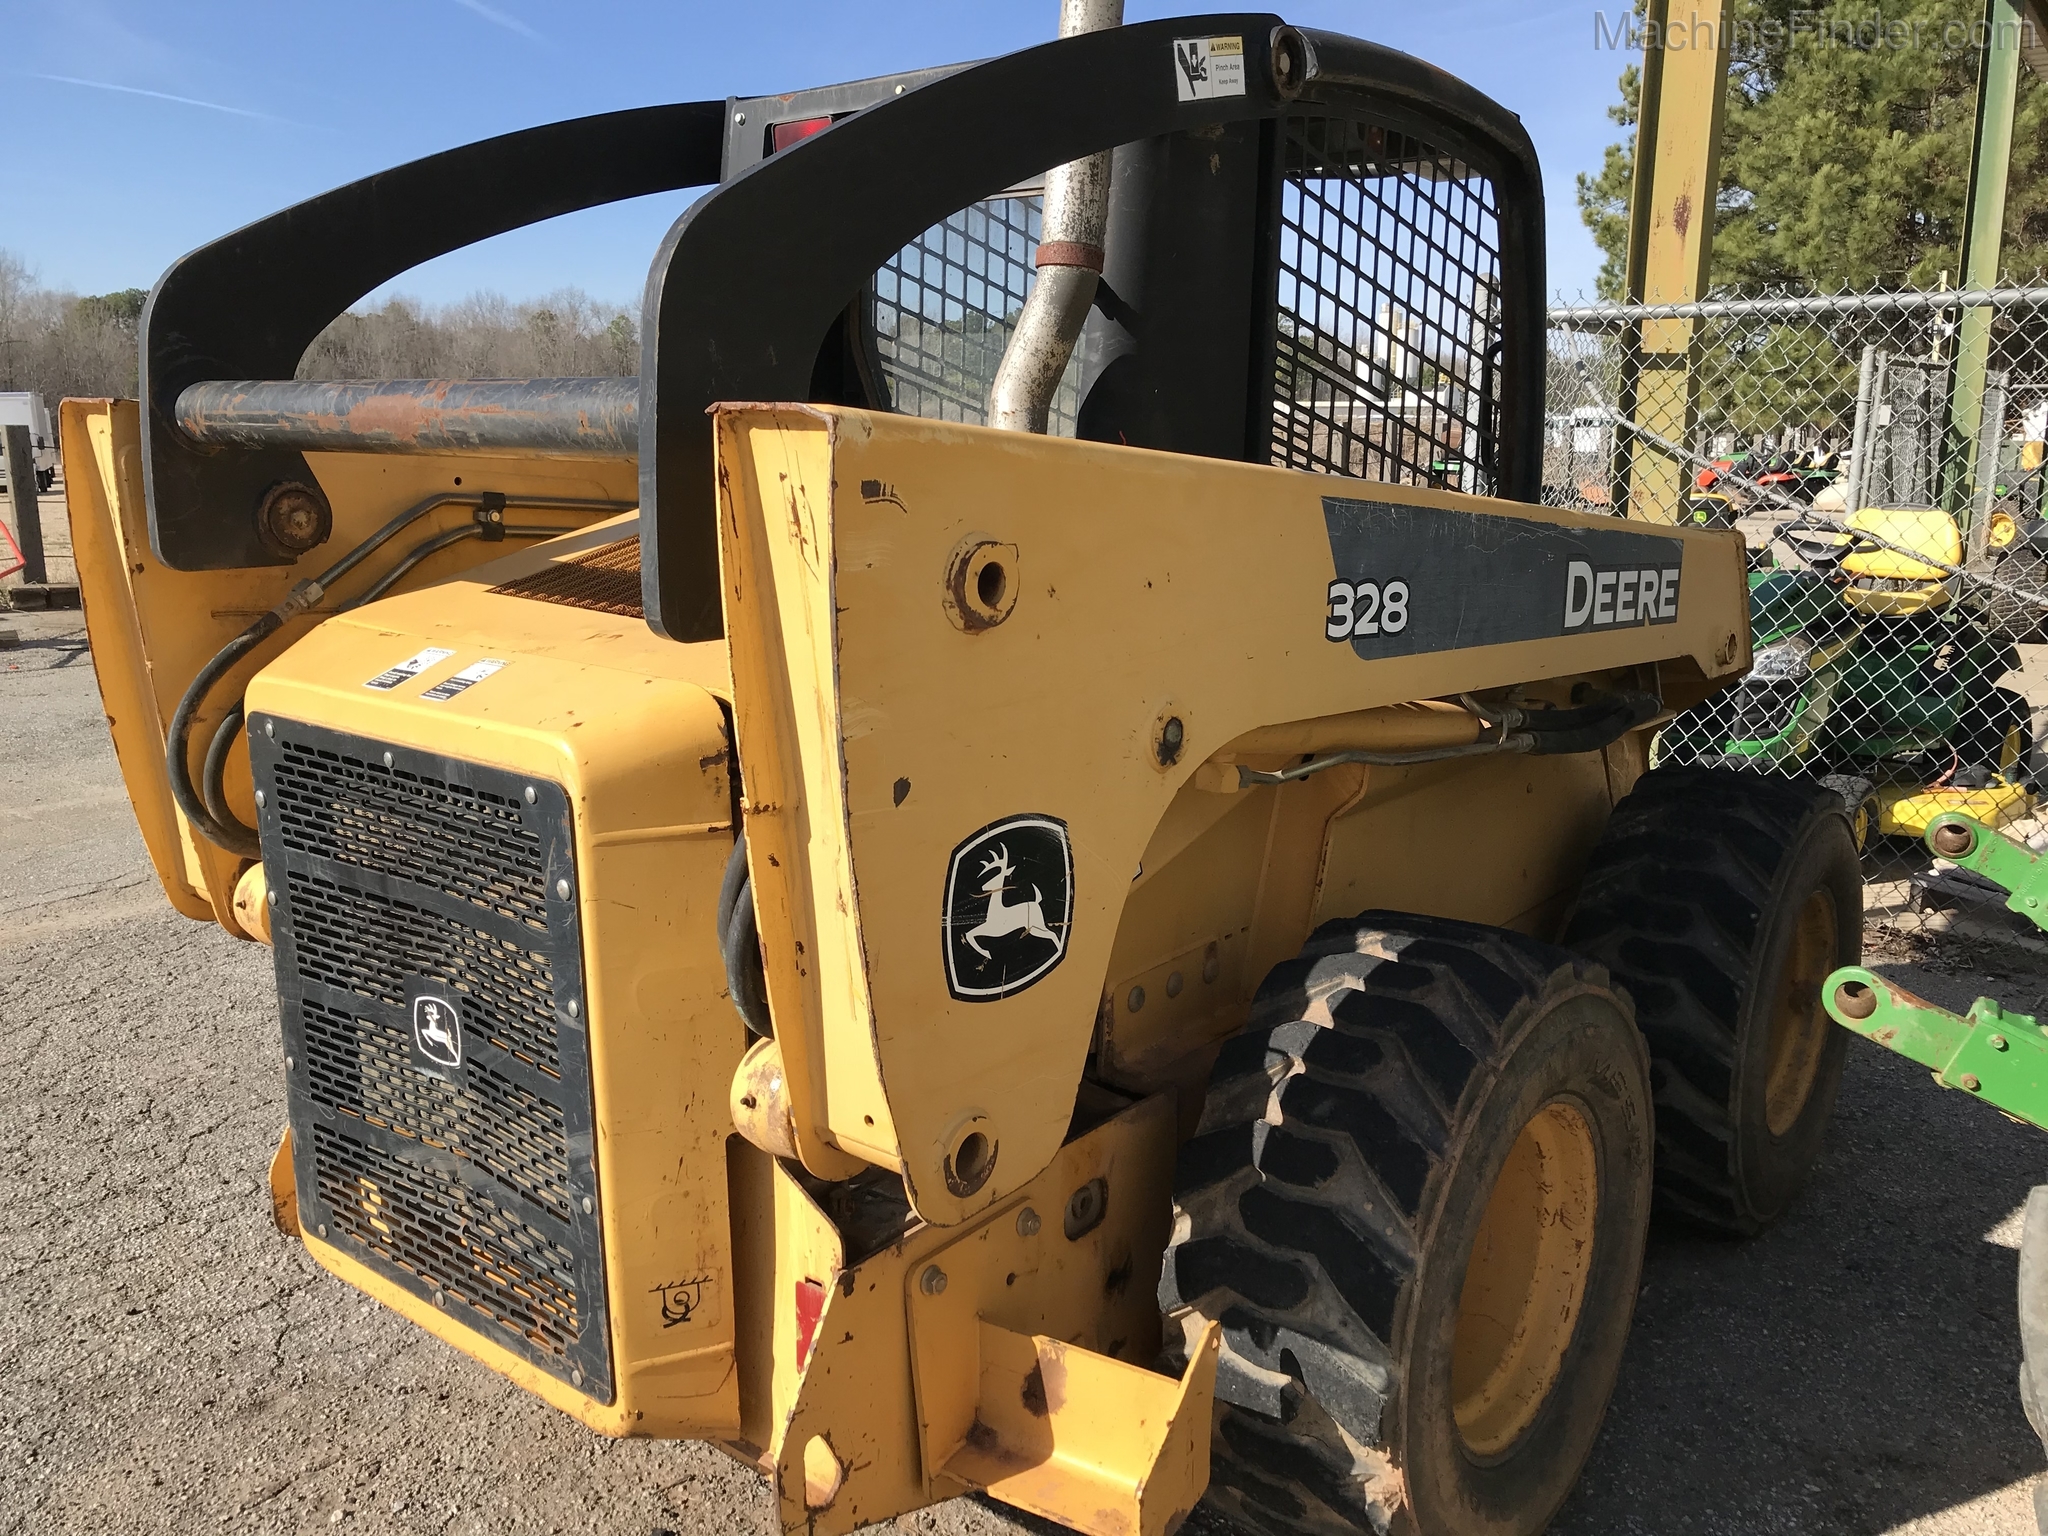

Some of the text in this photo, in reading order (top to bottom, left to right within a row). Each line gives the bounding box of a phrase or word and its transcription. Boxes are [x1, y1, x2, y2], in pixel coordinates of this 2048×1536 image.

[1215, 42, 1240, 51] WARNING
[1326, 580, 1410, 639] 328
[1563, 560, 1680, 629] DEERE
